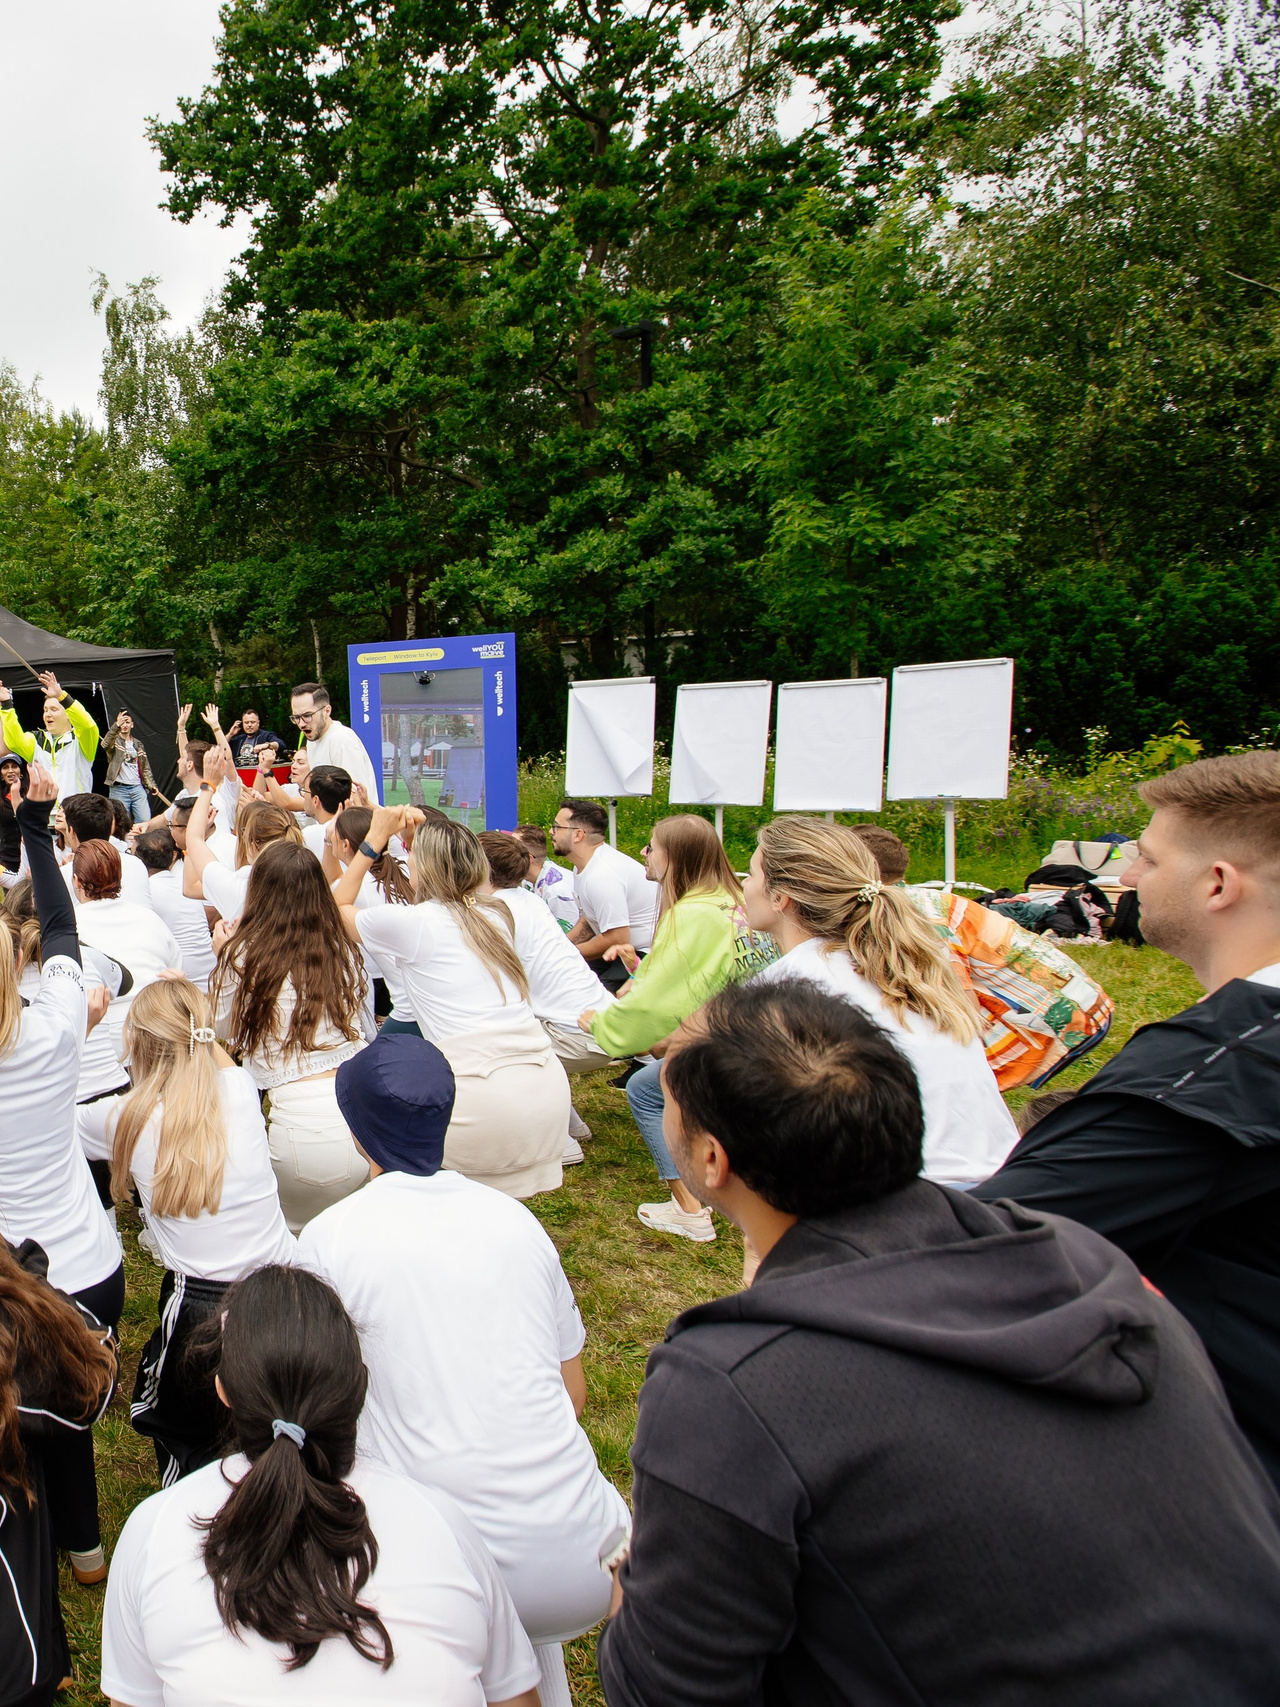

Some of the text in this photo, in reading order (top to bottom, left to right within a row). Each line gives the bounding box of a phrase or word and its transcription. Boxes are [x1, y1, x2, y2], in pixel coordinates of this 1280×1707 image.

[426, 651, 439, 659] Kyiv
[472, 644, 504, 652] wellYOU
[361, 680, 369, 712] welltech
[495, 671, 503, 705] welltech
